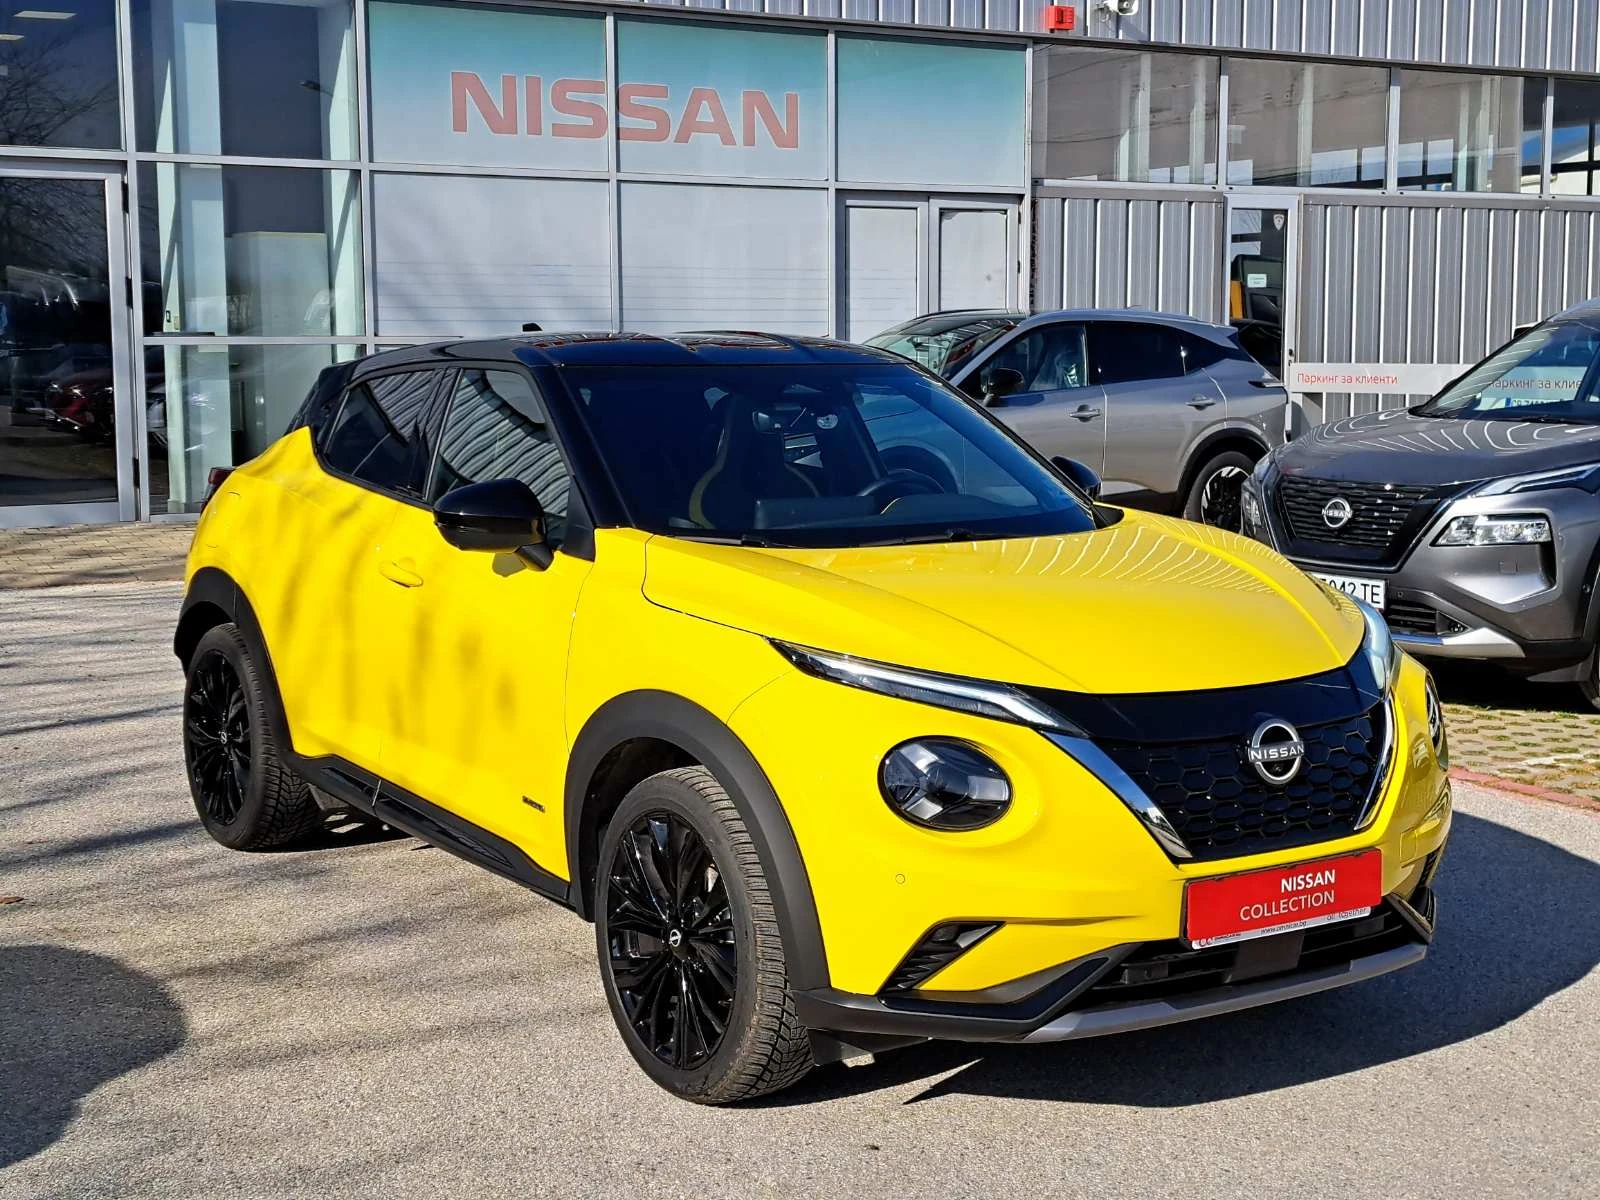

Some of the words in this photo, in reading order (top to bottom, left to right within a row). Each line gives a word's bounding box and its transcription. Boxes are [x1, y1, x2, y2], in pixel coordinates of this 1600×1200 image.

[451, 71, 799, 149] NISSAN
[1297, 373, 1338, 385] Паркинг
[1341, 375, 1353, 384] за
[1356, 375, 1398, 384] клиенти
[1539, 380, 1552, 389] за
[1361, 583, 1381, 604] TE
[1250, 744, 1304, 760] NISSAN
[1281, 869, 1336, 893] NISSAN
[1240, 890, 1335, 921] COLLECTION
